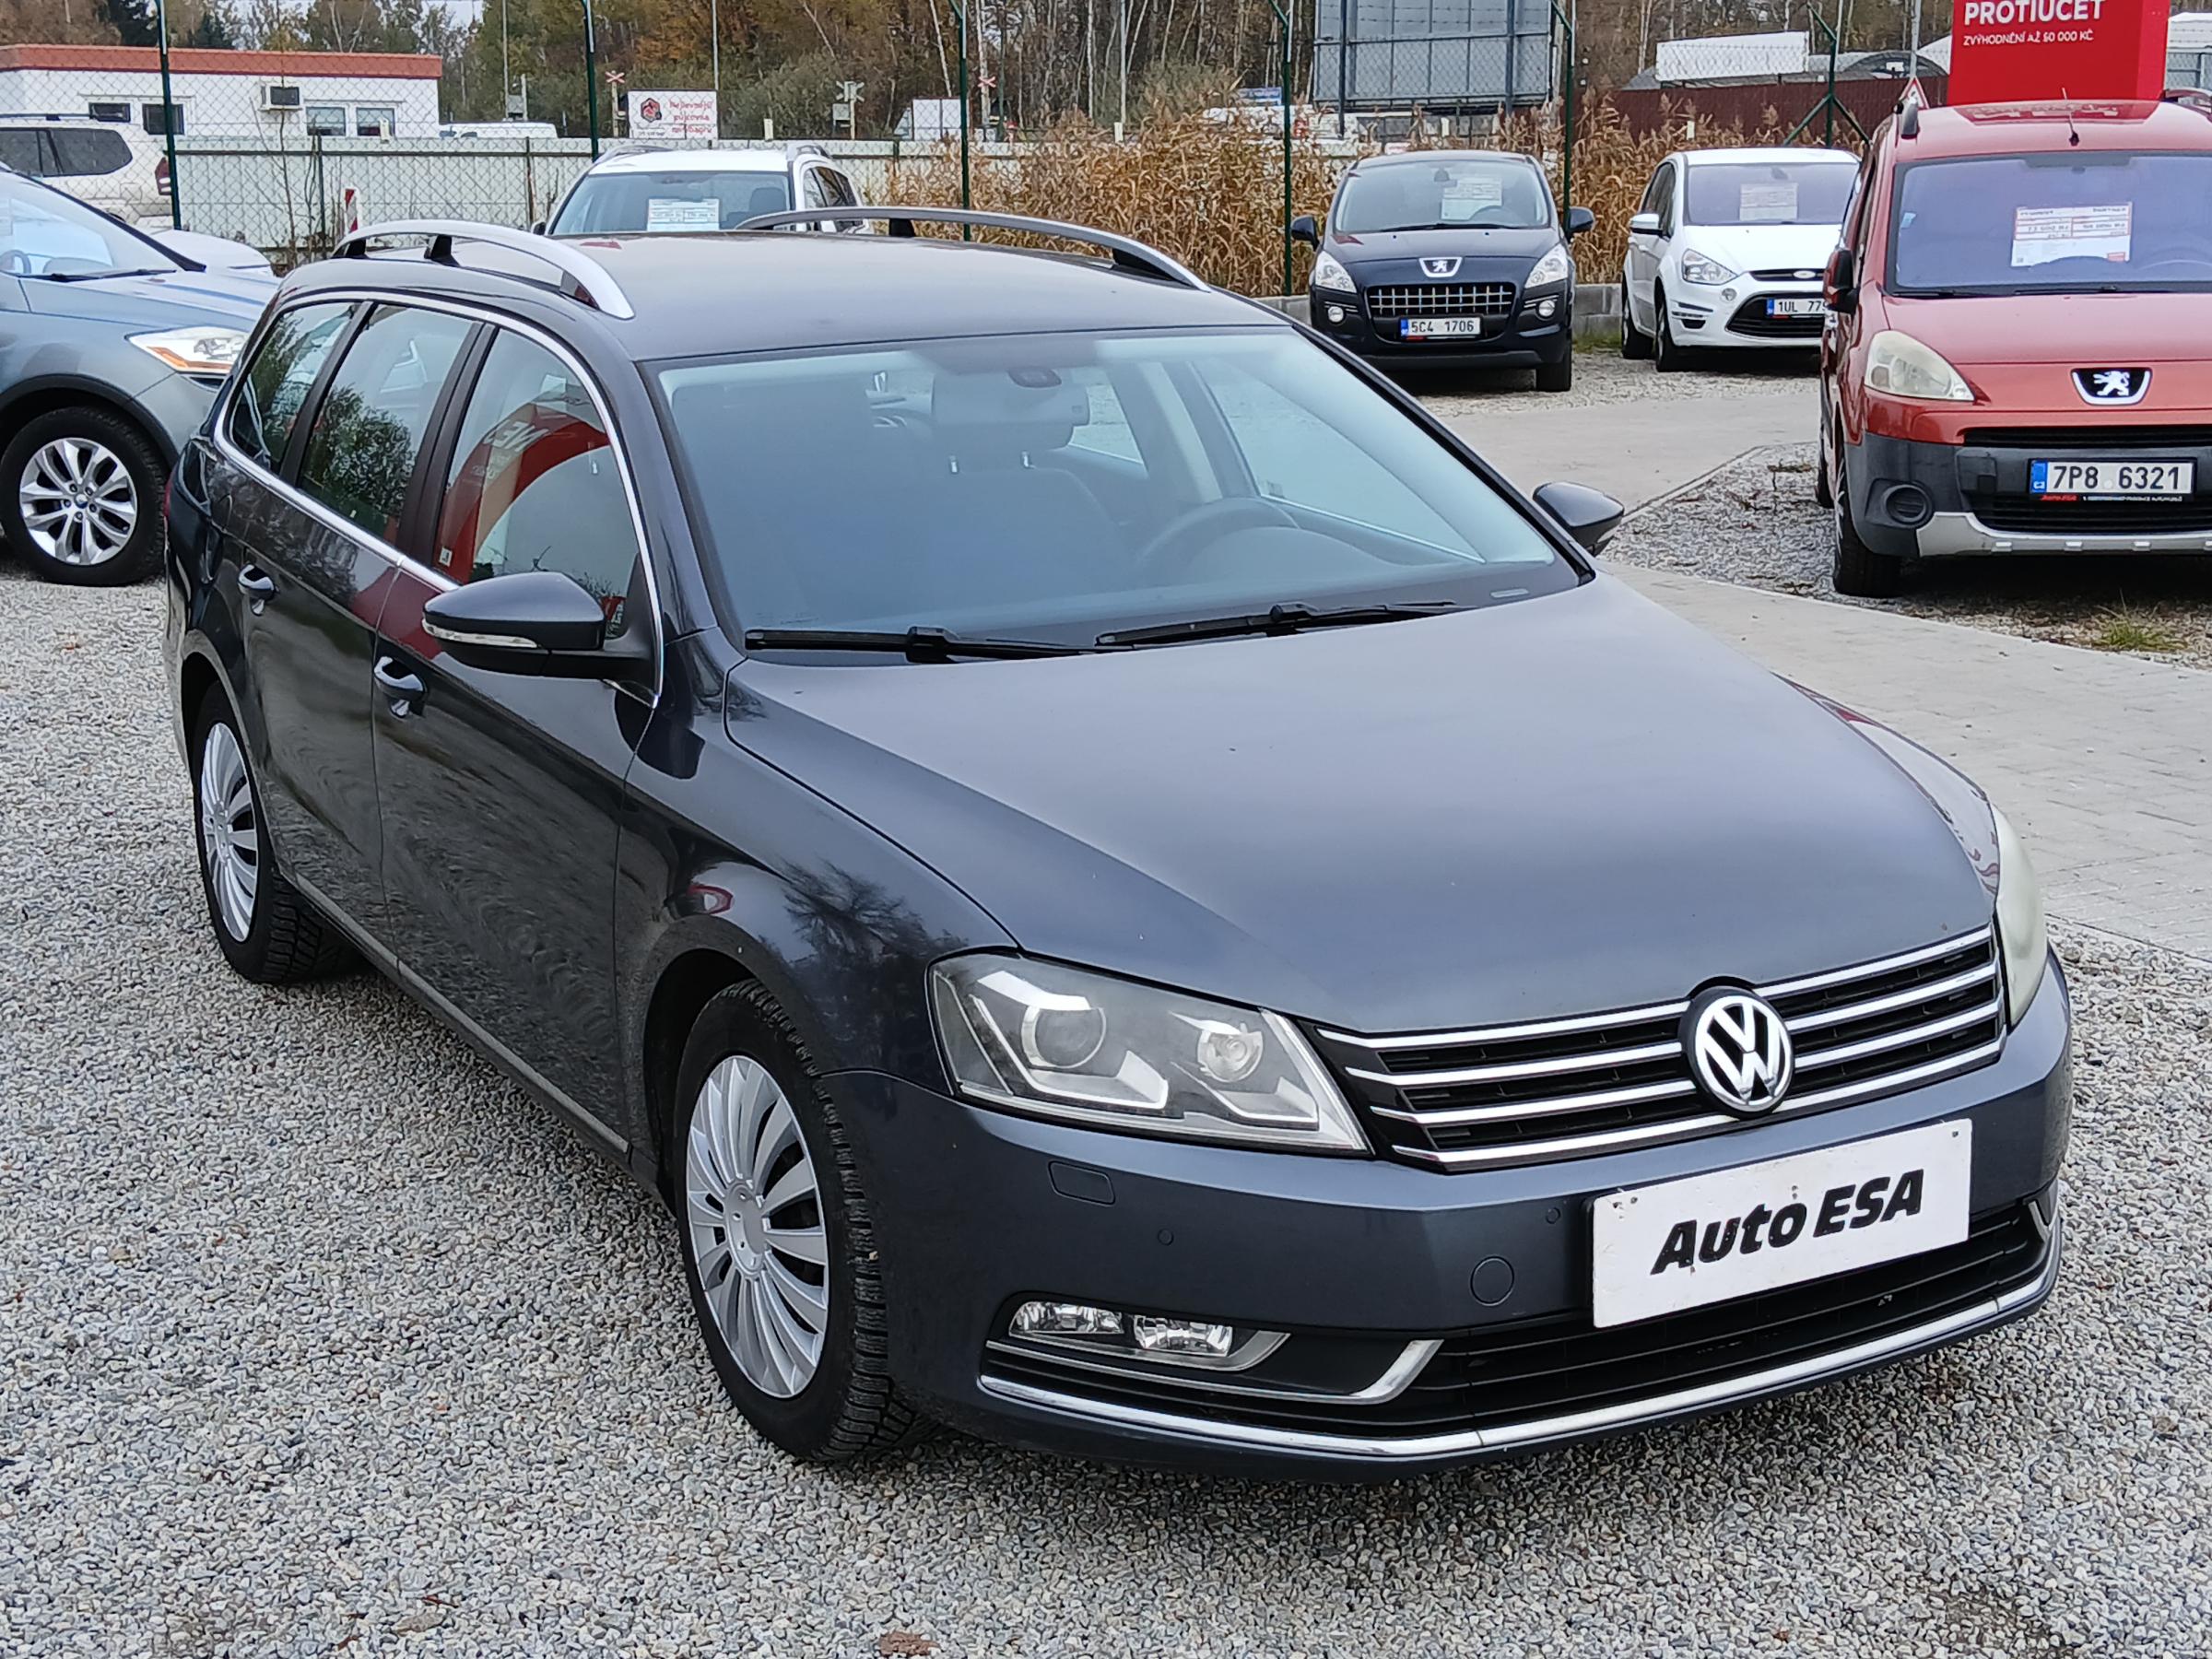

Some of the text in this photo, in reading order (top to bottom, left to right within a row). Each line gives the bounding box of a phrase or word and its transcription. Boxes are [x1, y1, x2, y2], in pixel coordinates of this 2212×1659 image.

[2057, 30, 2077, 42] 000
[1778, 300, 1798, 312] 1UL
[1411, 320, 1475, 333] 5C4 1706
[2053, 465, 2180, 490] 7P8 6321
